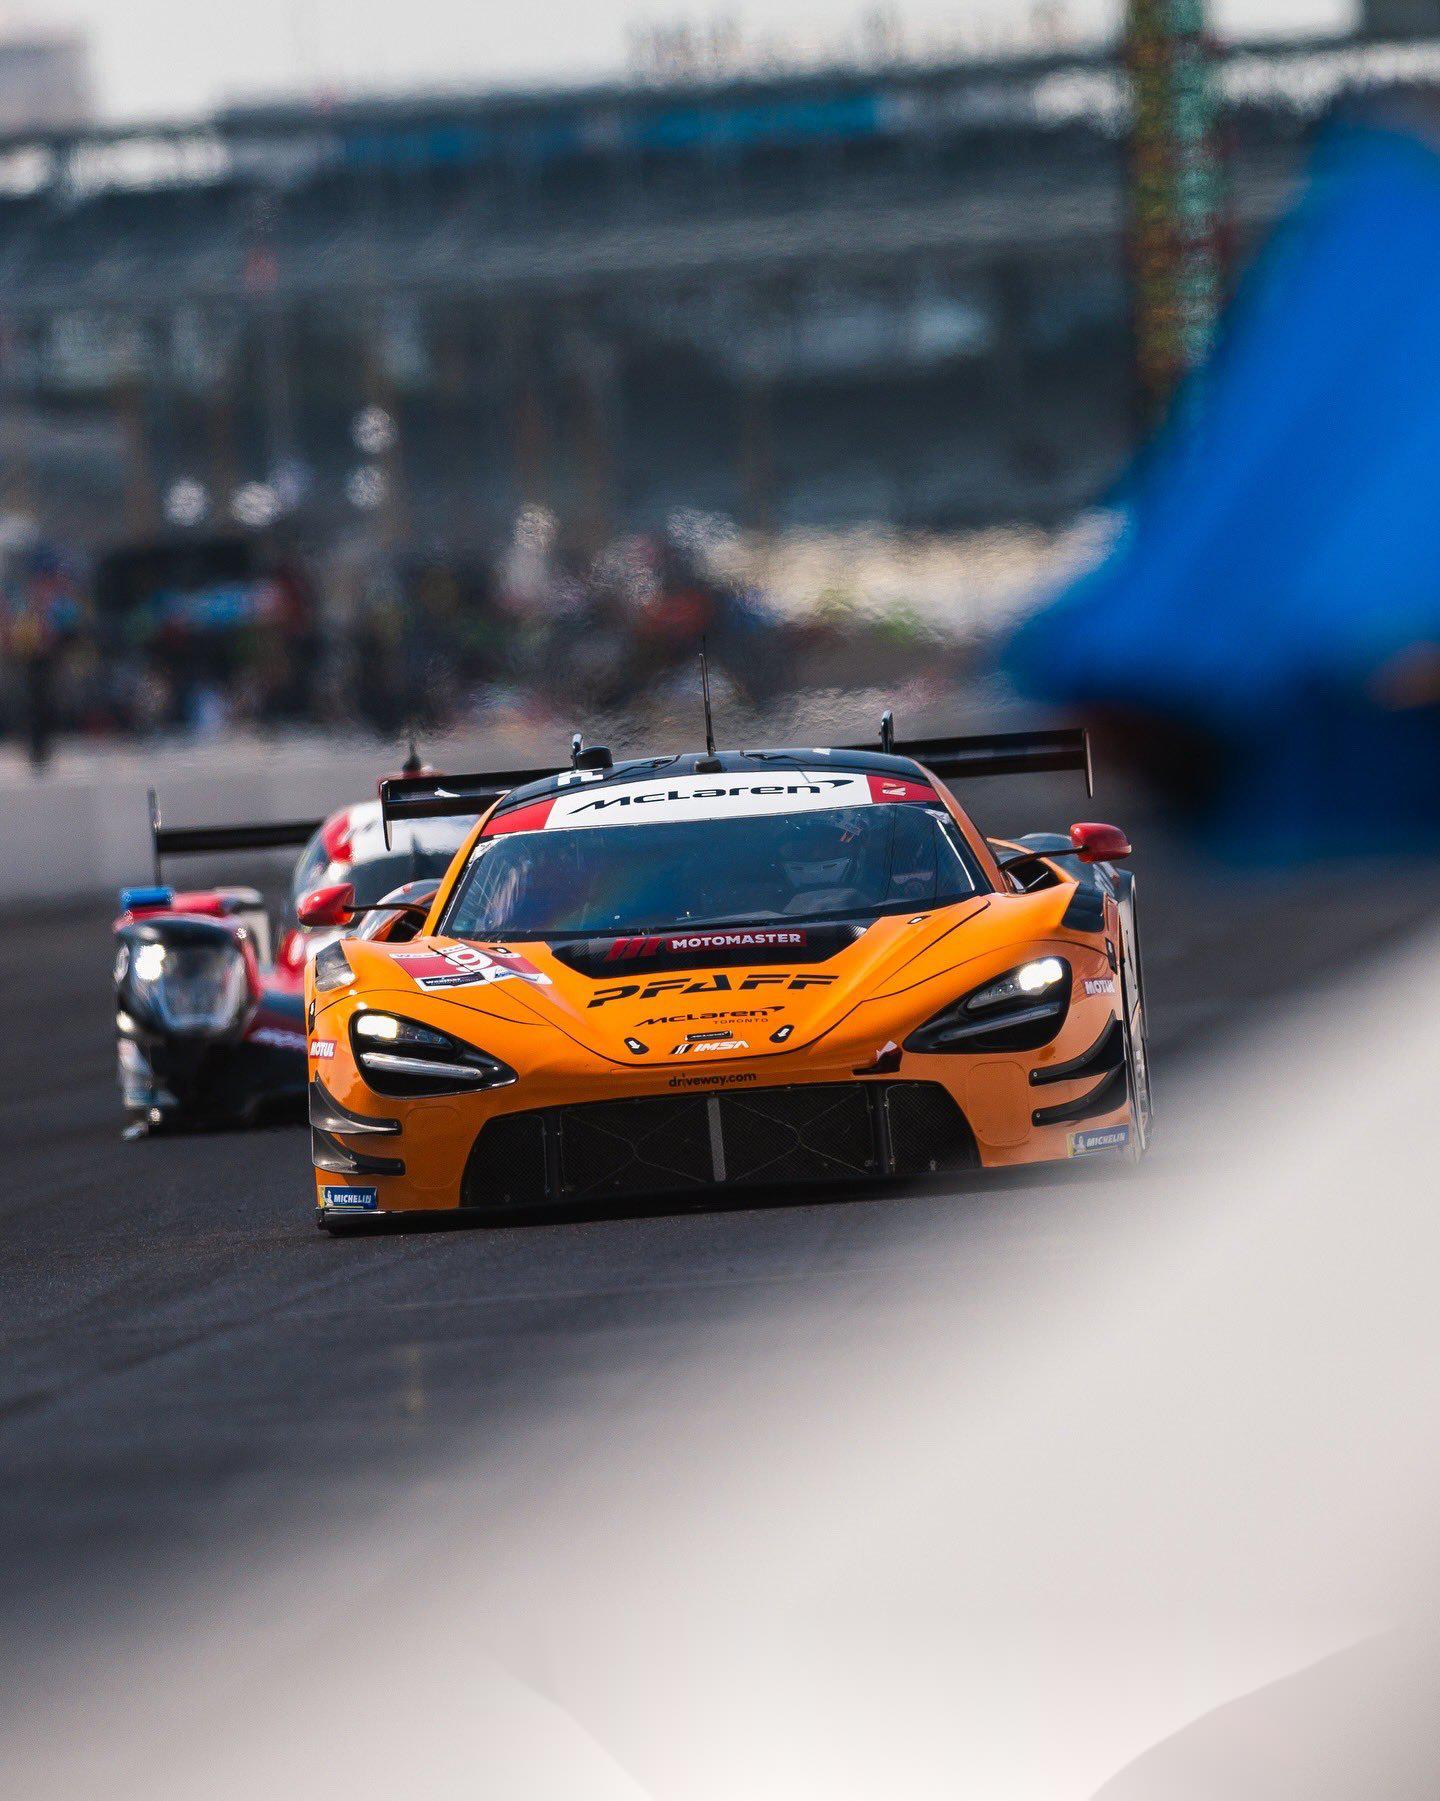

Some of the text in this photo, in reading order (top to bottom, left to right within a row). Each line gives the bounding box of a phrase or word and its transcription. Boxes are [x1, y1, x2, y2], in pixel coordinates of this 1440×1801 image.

[569, 779, 855, 815] McLaren
[671, 932, 801, 950] MOTOMASTER
[444, 948, 493, 972] 9
[586, 973, 840, 1009] PFAFF
[634, 1005, 785, 1027] McLaren
[310, 1040, 335, 1057] MOTUL
[693, 1040, 750, 1053] IMSA
[668, 1071, 757, 1087] driveway.com
[1086, 1132, 1126, 1148] MICHELIN
[333, 1194, 372, 1204] MICHELIN
